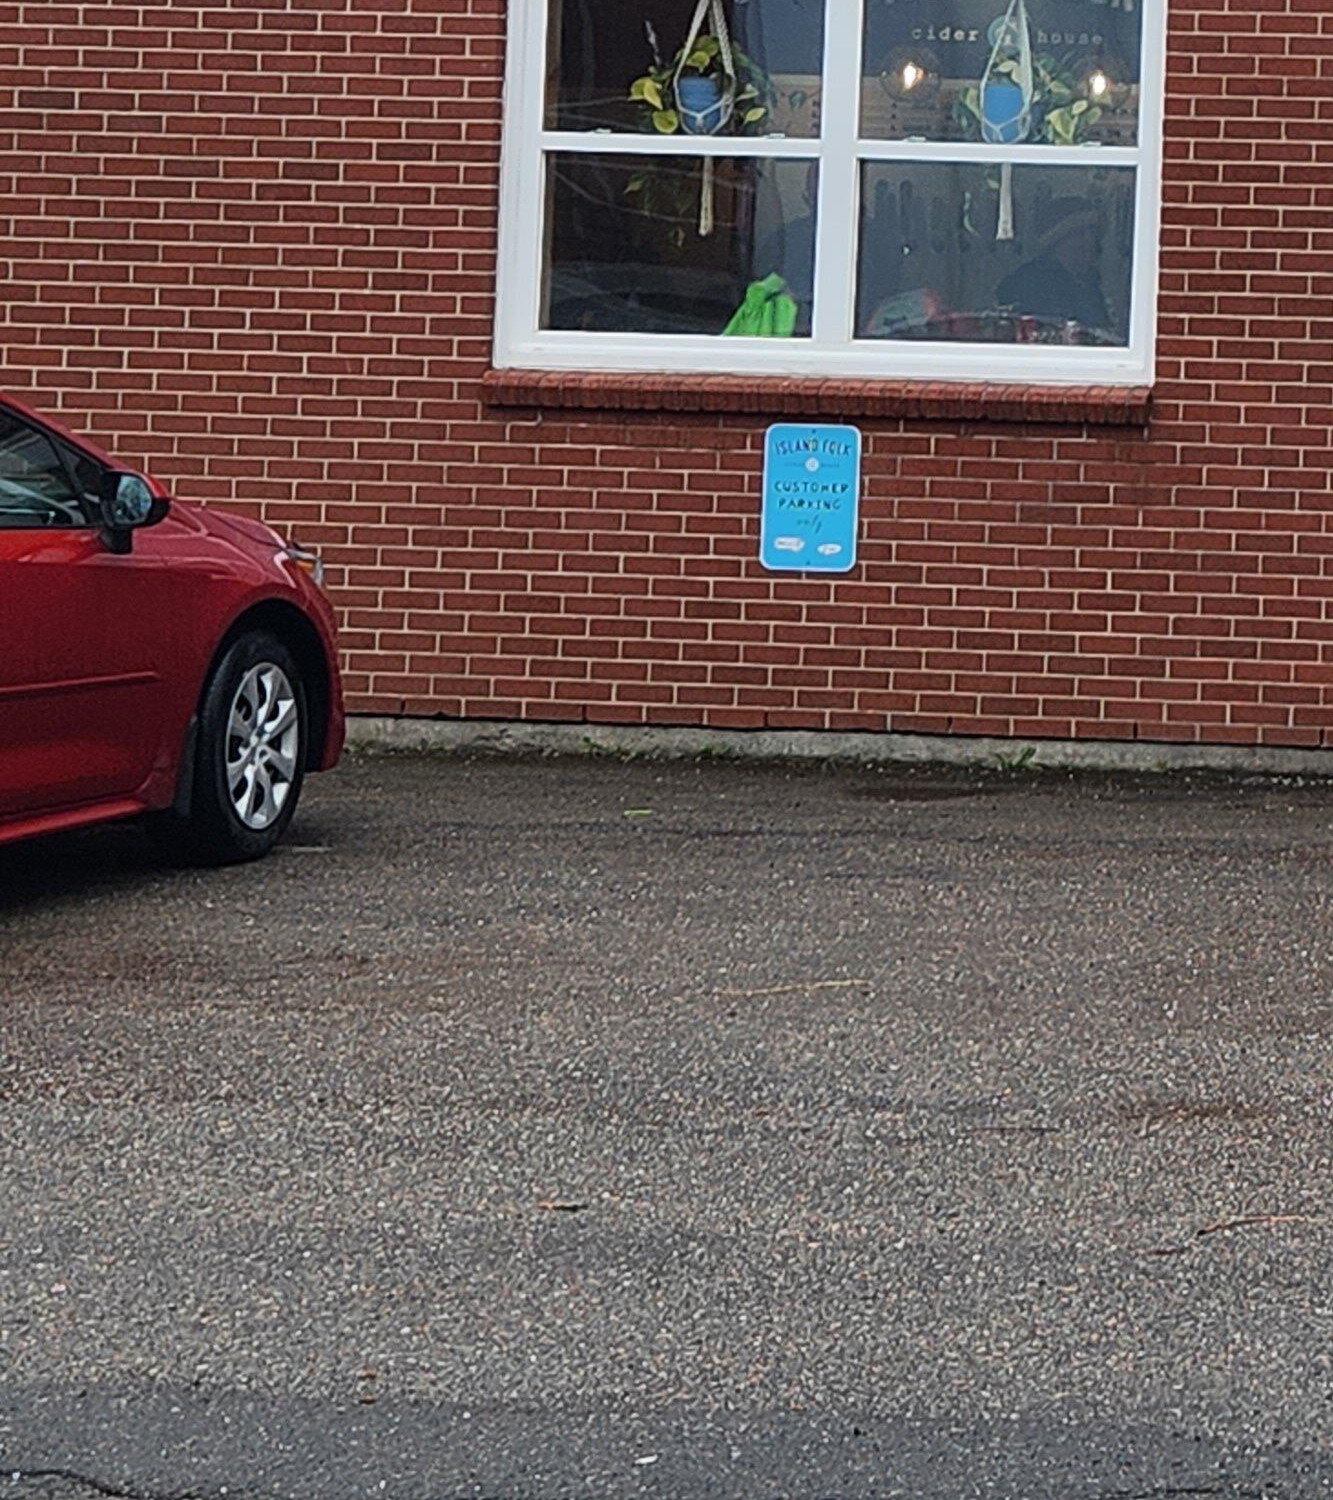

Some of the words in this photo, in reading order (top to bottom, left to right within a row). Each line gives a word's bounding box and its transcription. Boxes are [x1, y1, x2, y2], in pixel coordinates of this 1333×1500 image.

[911, 25, 978, 43] cider
[1037, 30, 1103, 46] house
[774, 438, 819, 455] ISLAND
[822, 439, 852, 457] FOLK
[774, 481, 849, 494] CUSTOMER
[778, 498, 842, 511] PARKING
